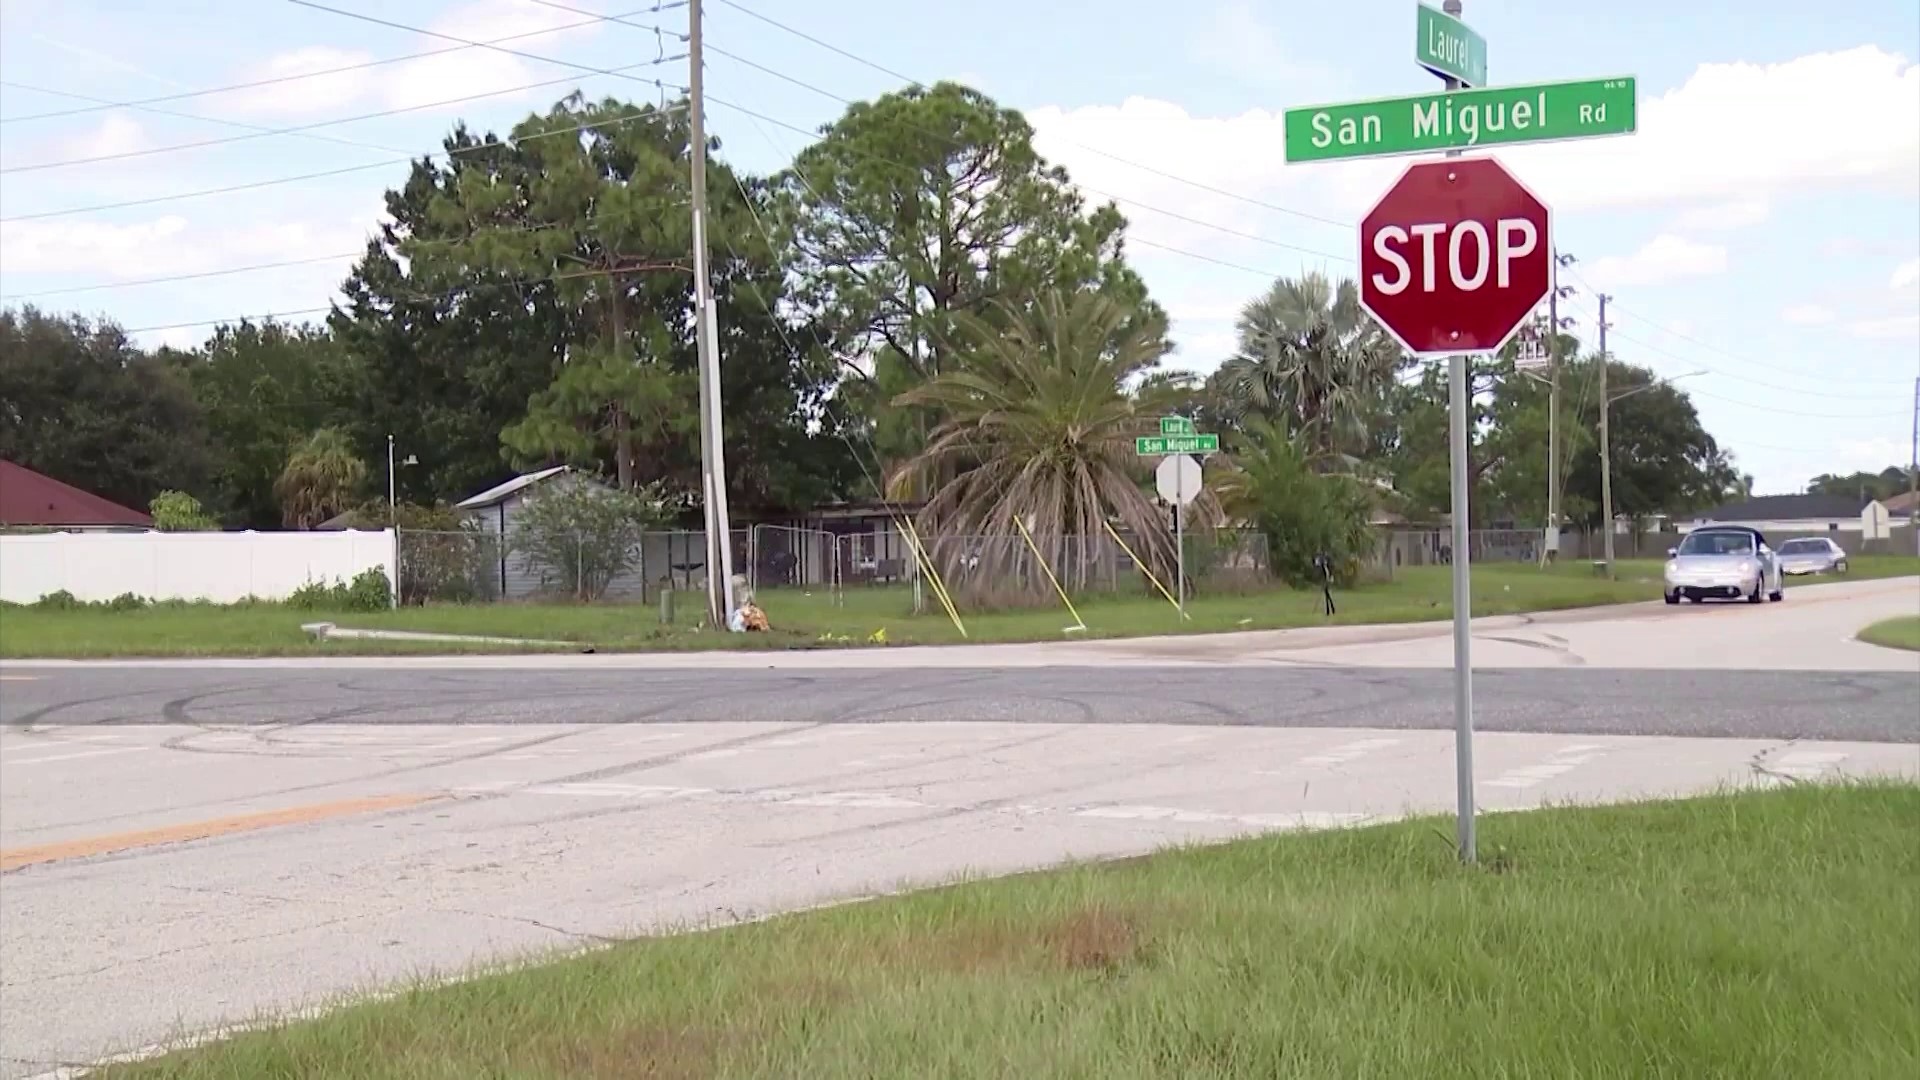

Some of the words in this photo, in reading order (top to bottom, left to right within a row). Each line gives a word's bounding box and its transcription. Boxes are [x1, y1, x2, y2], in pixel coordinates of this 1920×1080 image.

[1429, 17, 1469, 72] Laurel
[1311, 112, 1382, 148] San
[1413, 91, 1546, 144] Miguel
[1579, 102, 1607, 124] Rd
[1372, 218, 1538, 295] STOP
